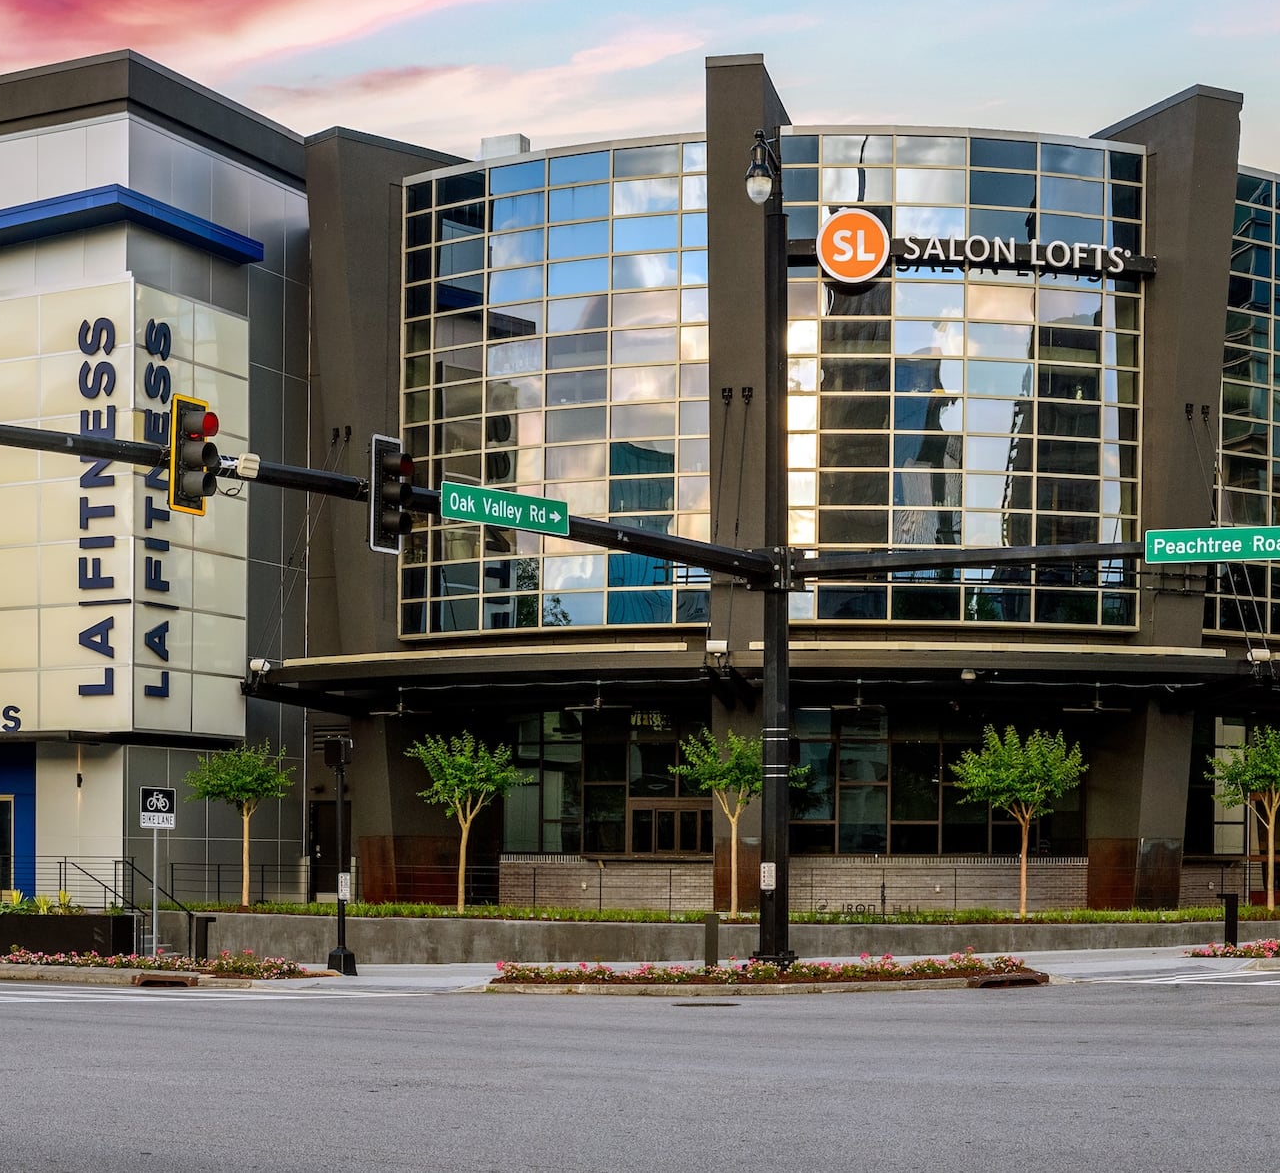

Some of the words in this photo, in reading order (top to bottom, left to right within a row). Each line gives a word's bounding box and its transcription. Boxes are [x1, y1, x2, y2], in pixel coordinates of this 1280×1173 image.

[832, 229, 876, 263] SL
[903, 234, 1016, 264] SALON
[450, 492, 476, 513] Oak
[483, 497, 523, 524] Valley
[529, 505, 546, 524] Rd
[1153, 536, 1242, 555] Peachtree
[157, 814, 174, 825] LANE
